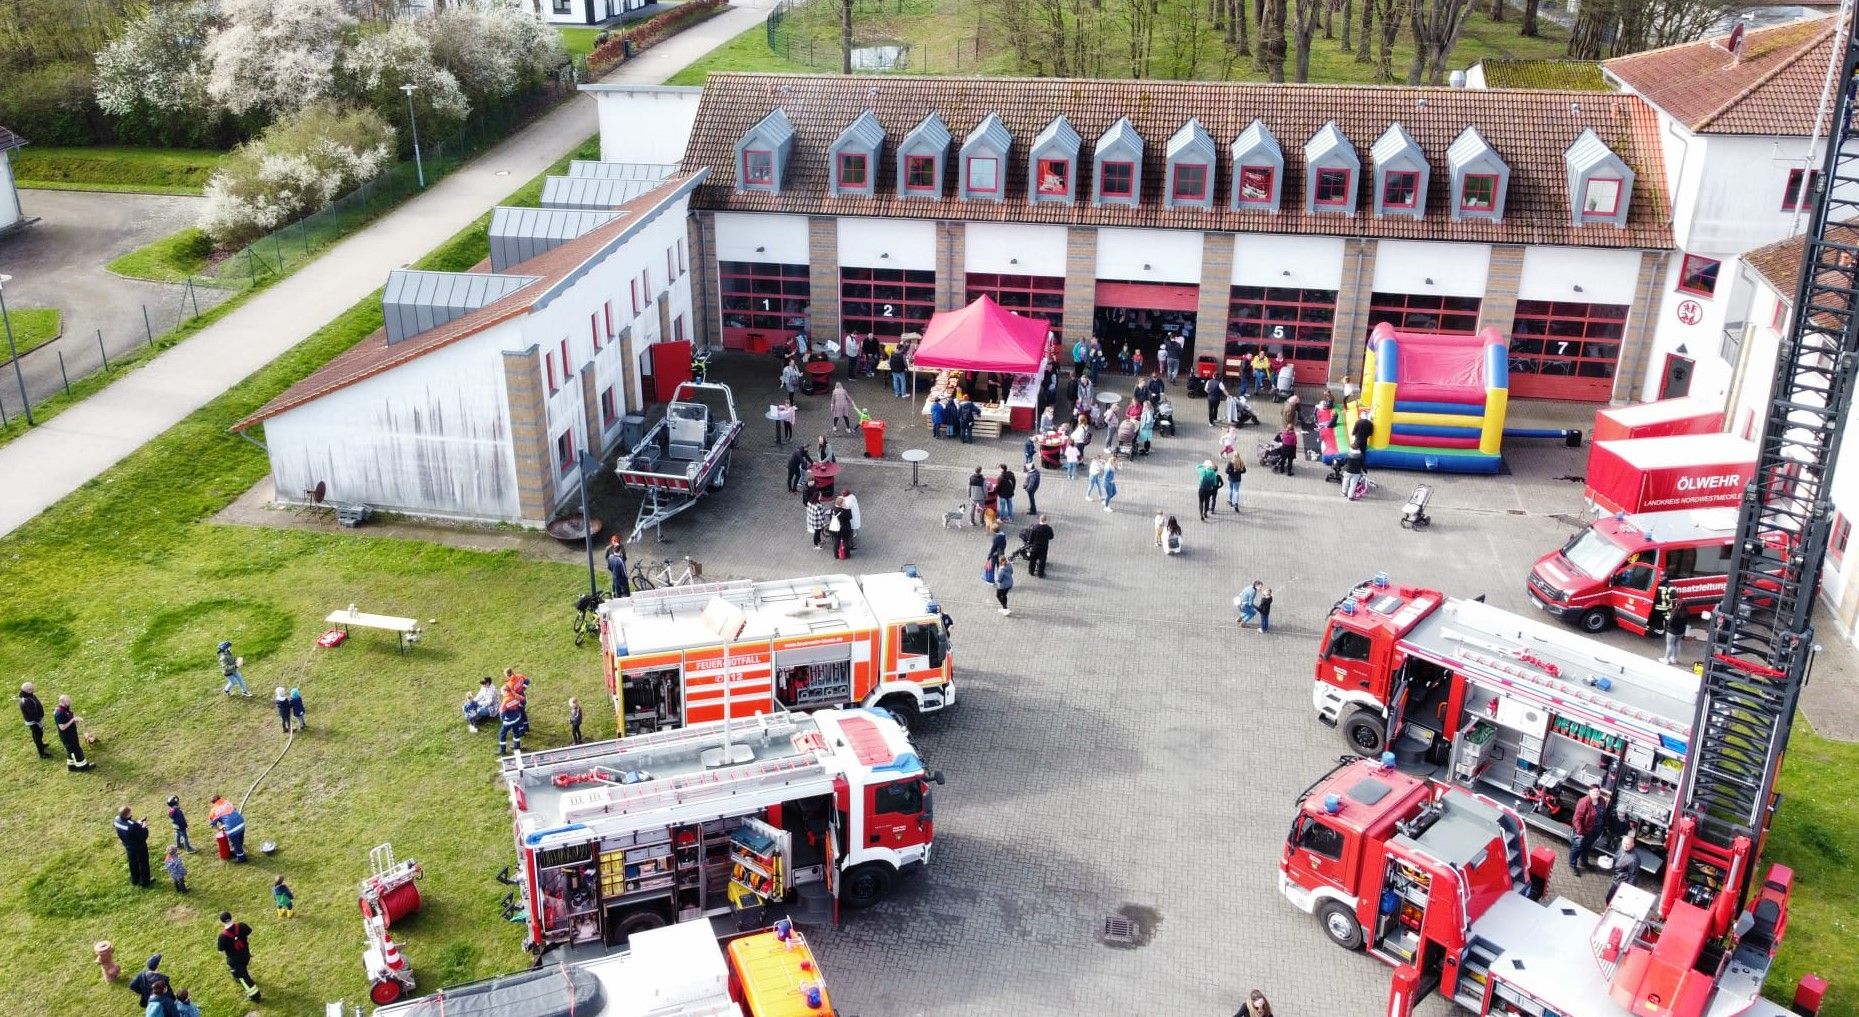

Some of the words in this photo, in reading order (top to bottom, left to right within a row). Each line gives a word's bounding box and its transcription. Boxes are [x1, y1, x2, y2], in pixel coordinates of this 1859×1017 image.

[762, 298, 770, 311] 1
[883, 304, 893, 317] 2
[1273, 325, 1284, 339] 5
[1557, 341, 1569, 355] 7
[1677, 474, 1740, 491] ÖLWEHR
[1644, 497, 1680, 507] LANDKREIS
[695, 655, 761, 671] FEUER-OTFALL
